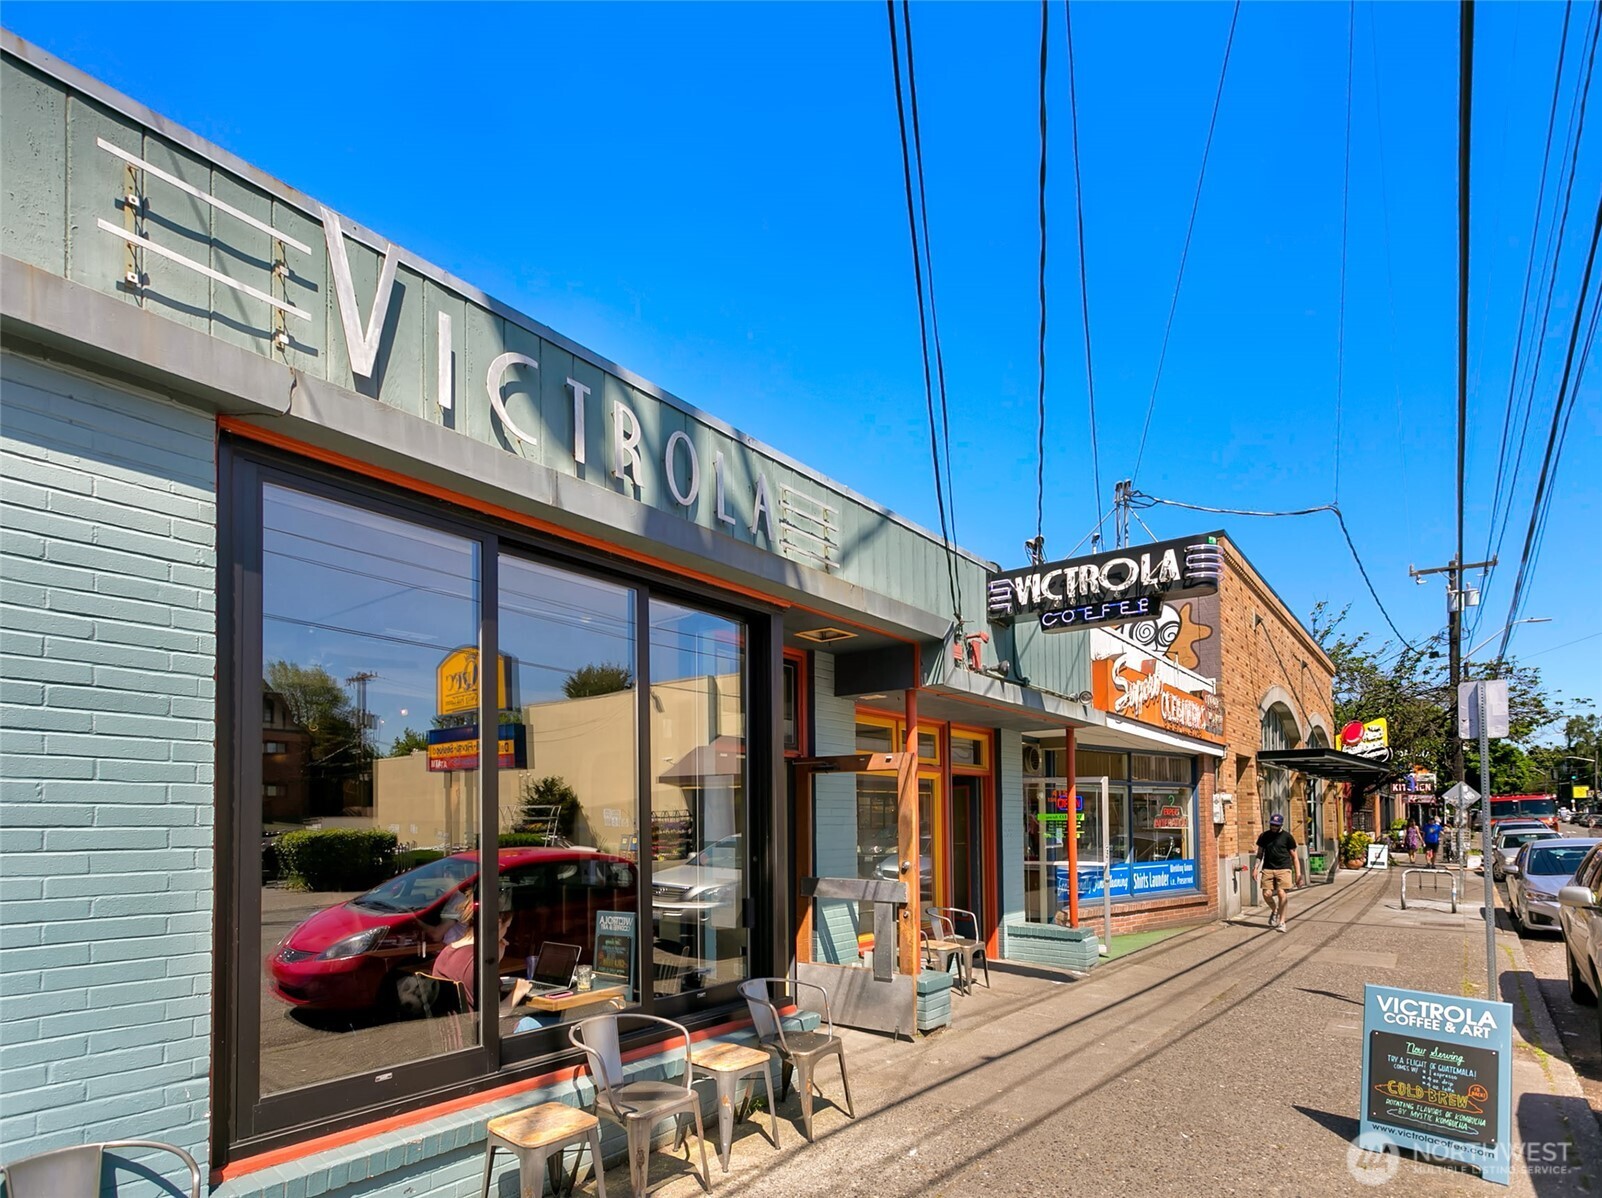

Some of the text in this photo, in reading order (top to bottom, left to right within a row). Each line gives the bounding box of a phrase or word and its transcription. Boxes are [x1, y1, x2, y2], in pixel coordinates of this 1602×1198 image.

[320, 206, 775, 541] VICTROLA
[1015, 548, 1180, 605] VICTROLA
[1042, 598, 1149, 626] COFFEE
[1392, 783, 1431, 791] KITHEN
[1057, 798, 1081, 808] OPN
[1134, 872, 1149, 890] Shirts
[1376, 994, 1498, 1029] VICTROLA
[1383, 1012, 1491, 1039] COFFEE & ART
[1387, 1054, 1399, 1062] TRY
[1399, 1056, 1405, 1065] A
[1406, 1058, 1427, 1068] FLIGHT
[1429, 1062, 1437, 1070] OF
[1406, 1041, 1465, 1066] Now Serving
[1393, 1063, 1410, 1072] COMES
[1387, 1080, 1469, 1108] COLD BREW
[1385, 1098, 1414, 1110] ROTATING
[1416, 1104, 1442, 1117] FLAVORS
[1454, 1113, 1487, 1127] KOMBUCHA
[1410, 1111, 1432, 1121] MYSTIC
[1435, 1116, 1469, 1130] KOMBUCHA
[1371, 1123, 1495, 1158] www.victrolacoffee.com
